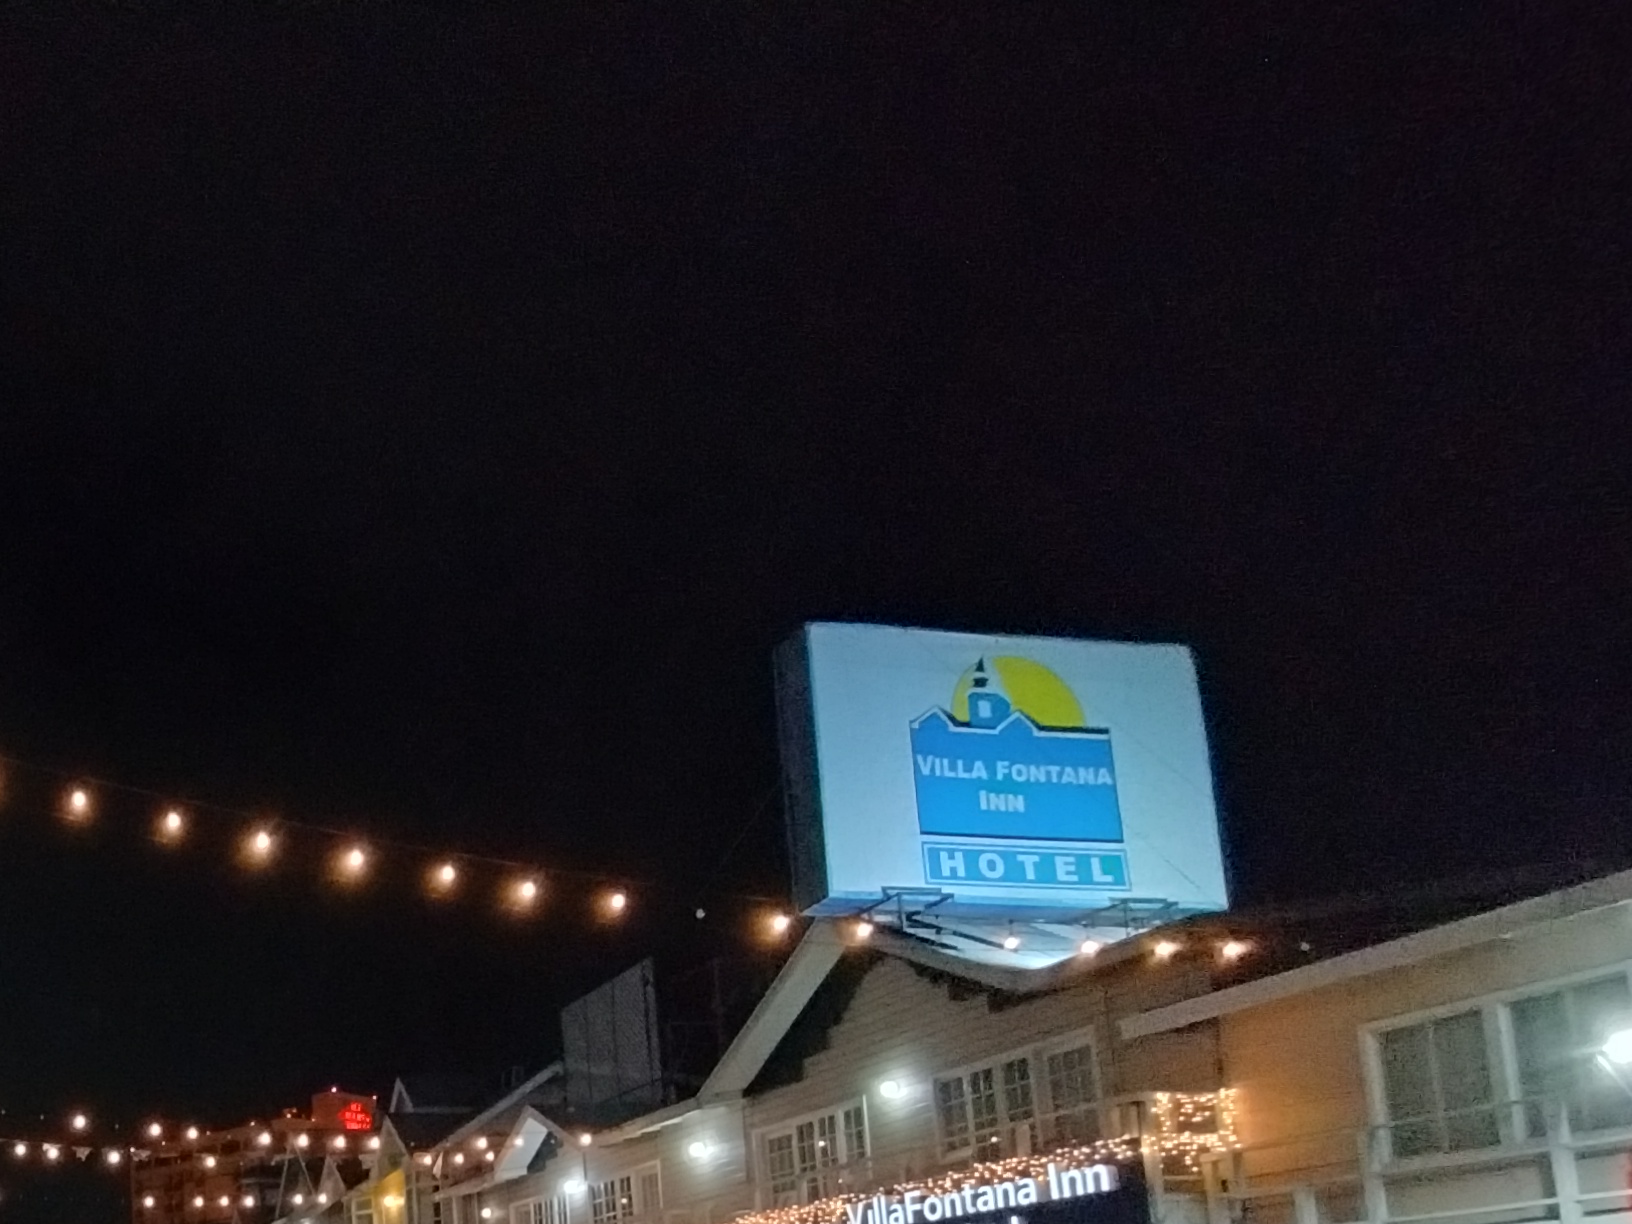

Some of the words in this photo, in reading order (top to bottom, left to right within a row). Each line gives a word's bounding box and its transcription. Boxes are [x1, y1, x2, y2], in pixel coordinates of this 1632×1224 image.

[916, 753, 989, 781] VILLA
[996, 760, 1113, 786] FONTANA
[978, 789, 1026, 814] INN
[939, 851, 1115, 883] HOTEL
[1046, 1161, 1113, 1200] Inn
